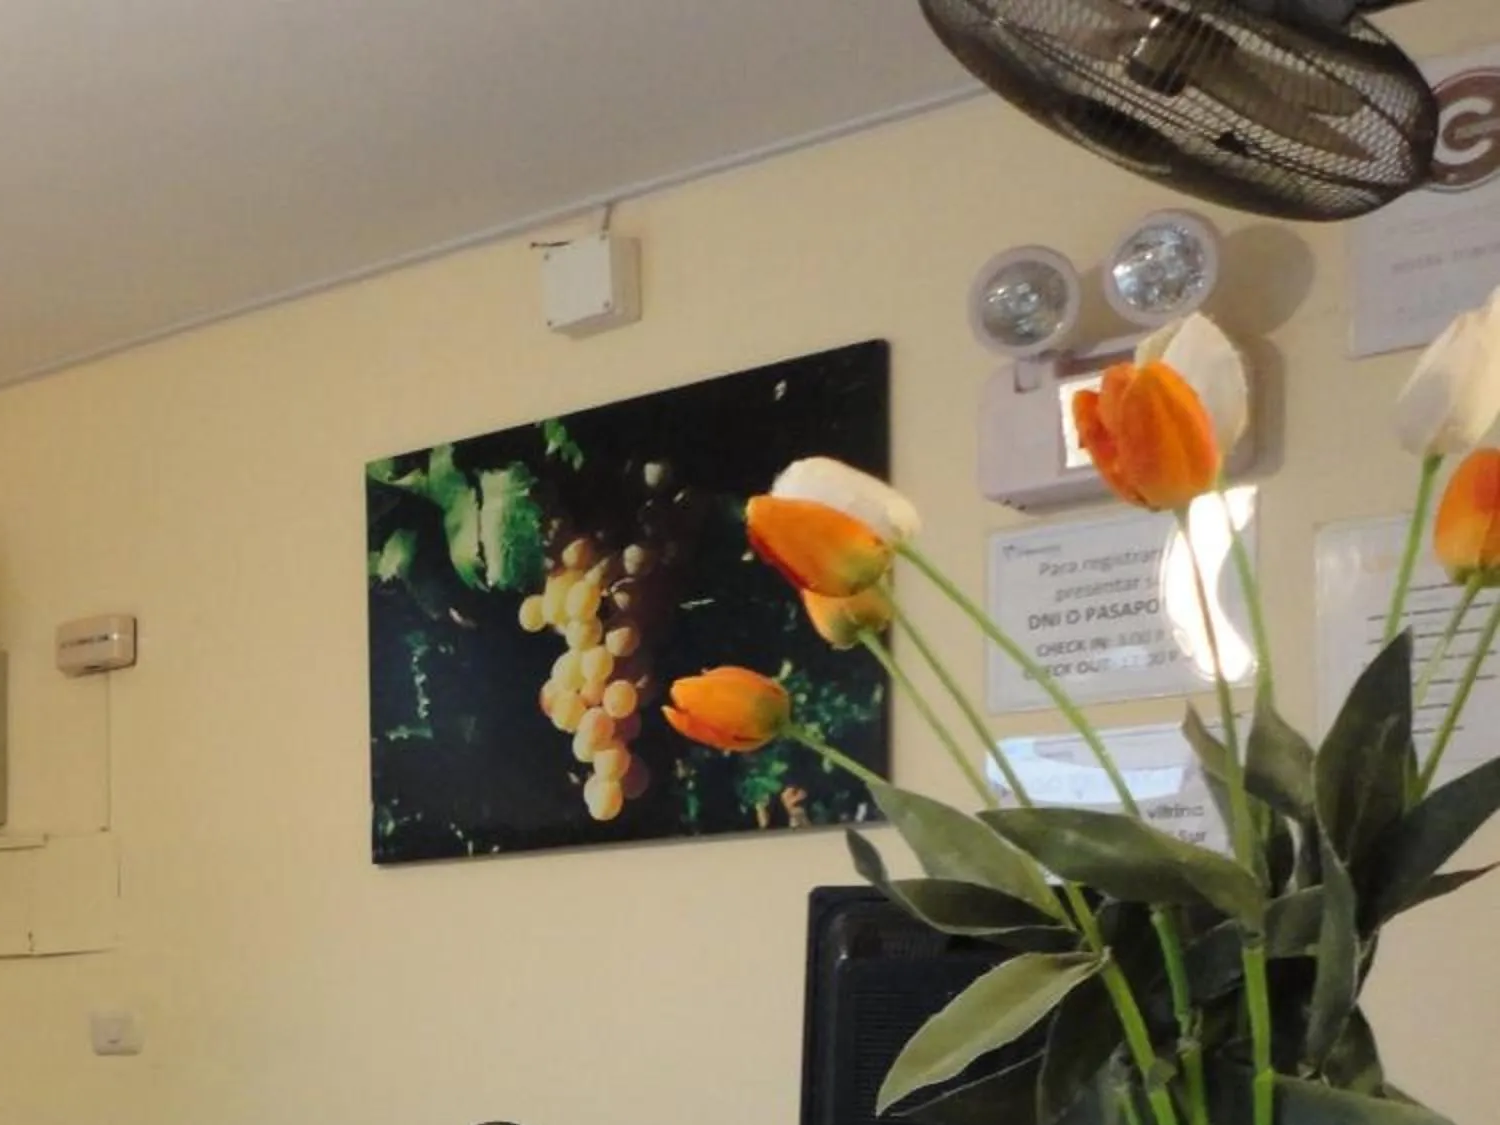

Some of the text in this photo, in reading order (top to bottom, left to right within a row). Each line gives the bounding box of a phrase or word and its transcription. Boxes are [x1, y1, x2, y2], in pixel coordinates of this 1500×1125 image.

[1027, 613, 1061, 630] DNI
[1085, 598, 1160, 622] PASAPO
[1022, 662, 1072, 681] CECK
